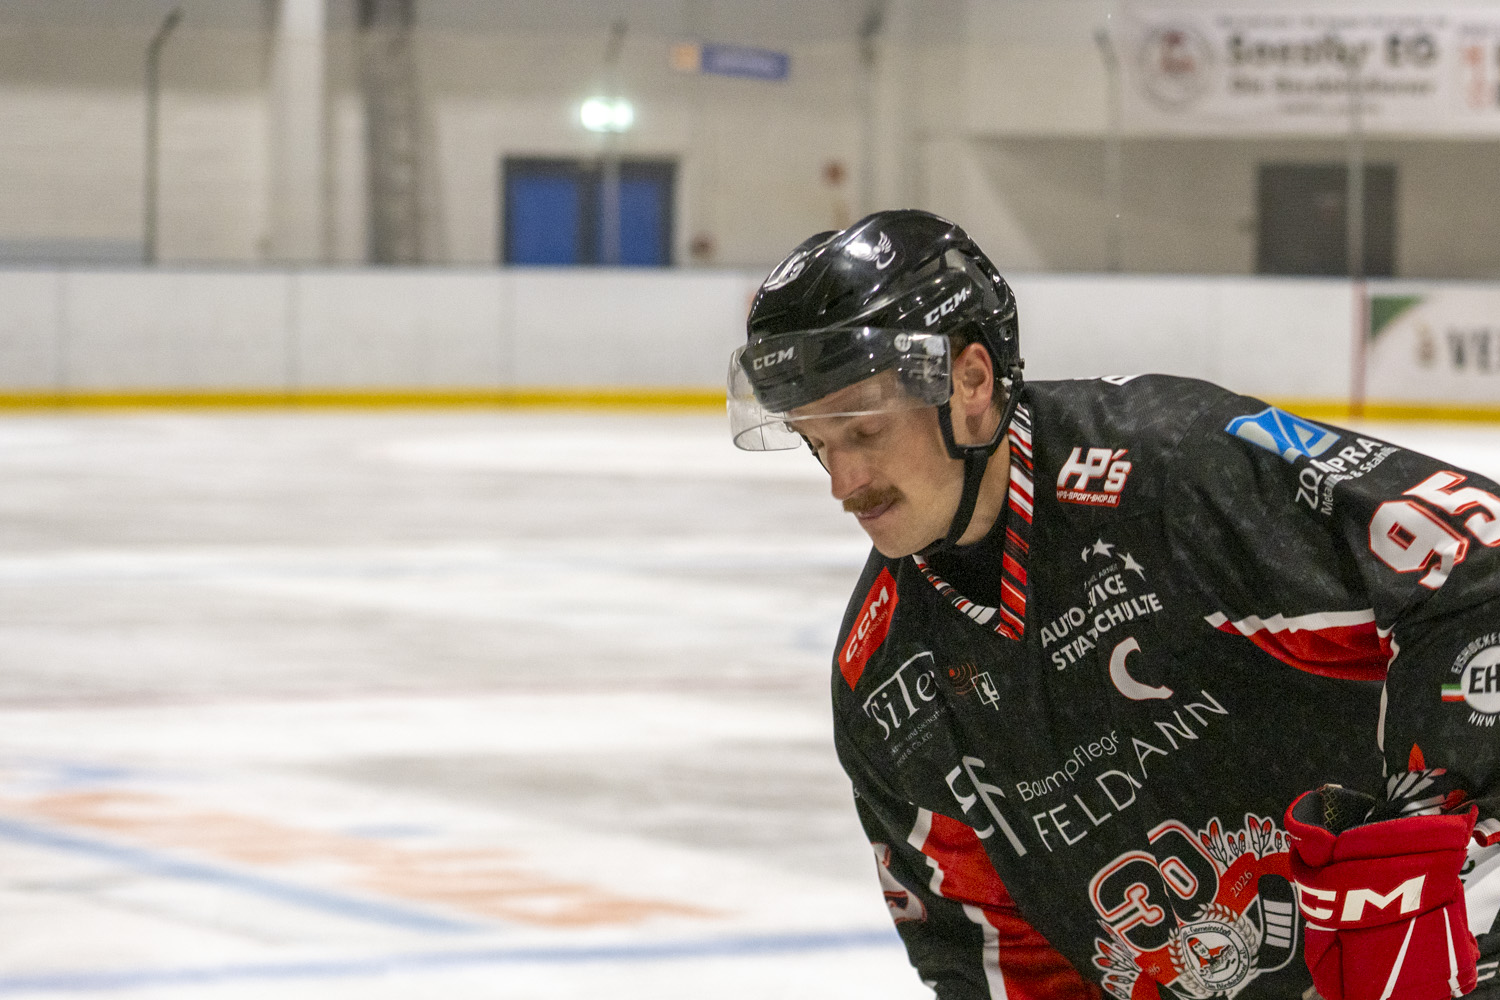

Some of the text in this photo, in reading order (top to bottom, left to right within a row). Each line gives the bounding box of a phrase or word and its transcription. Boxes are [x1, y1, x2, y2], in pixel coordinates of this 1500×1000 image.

[923, 287, 969, 326] CCM
[752, 347, 798, 371] CCM
[846, 586, 889, 663] CCM
[1109, 636, 1174, 700] C
[1468, 710, 1497, 727] NRW
[1016, 730, 1120, 802] Baumpflege
[1032, 690, 1229, 852] FELDANN
[1230, 870, 1253, 897] 2026
[1296, 874, 1426, 922] CM
